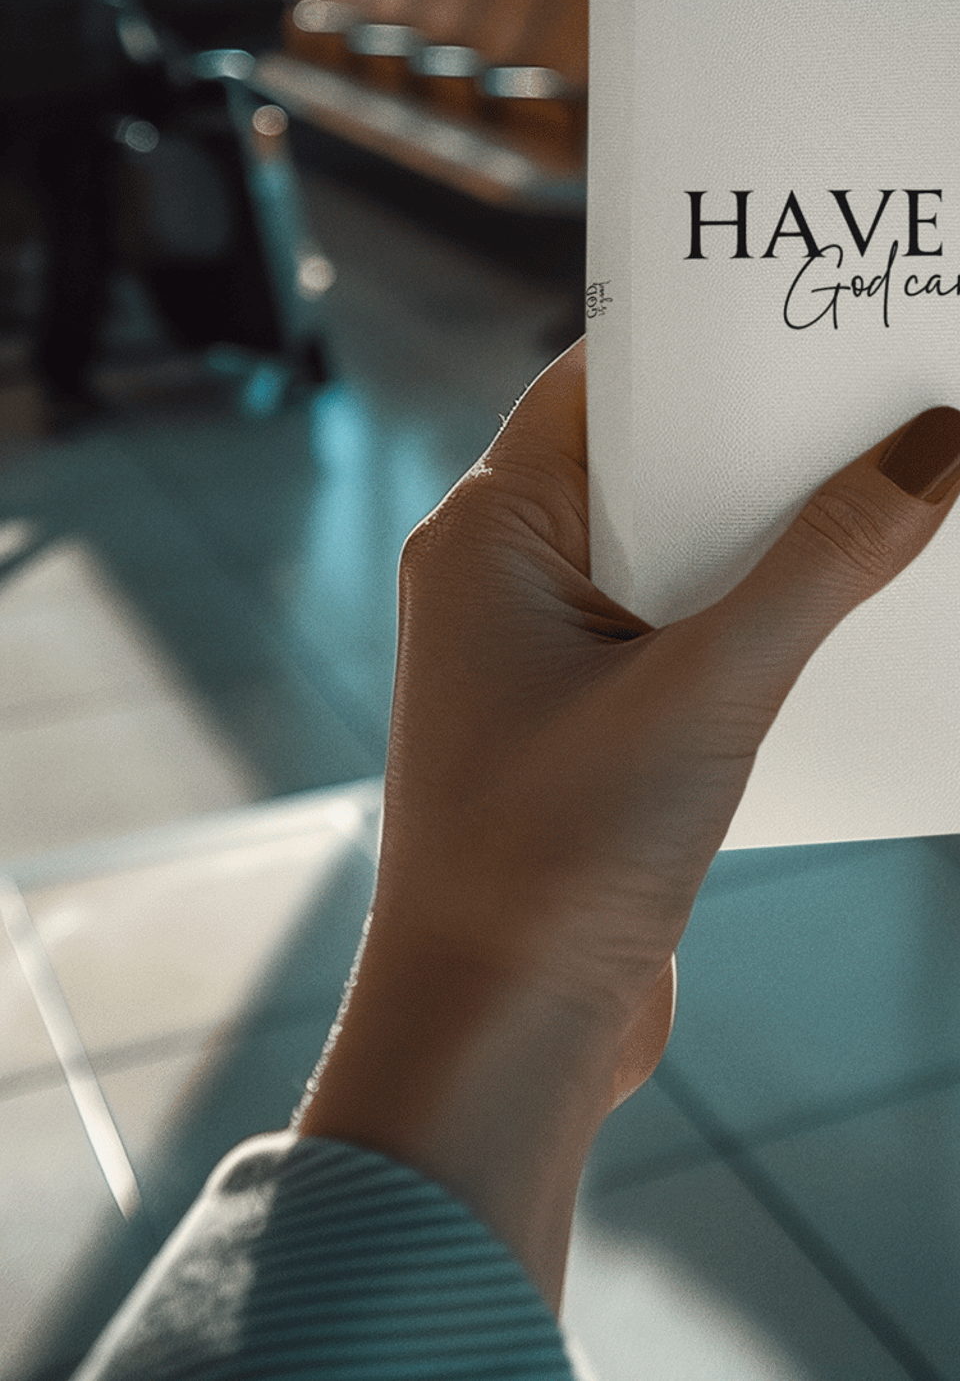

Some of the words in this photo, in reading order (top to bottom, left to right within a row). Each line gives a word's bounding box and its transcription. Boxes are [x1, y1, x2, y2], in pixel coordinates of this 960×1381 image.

[684, 188, 943, 260] HAVE
[585, 285, 598, 319] GOD
[783, 239, 899, 330] God
